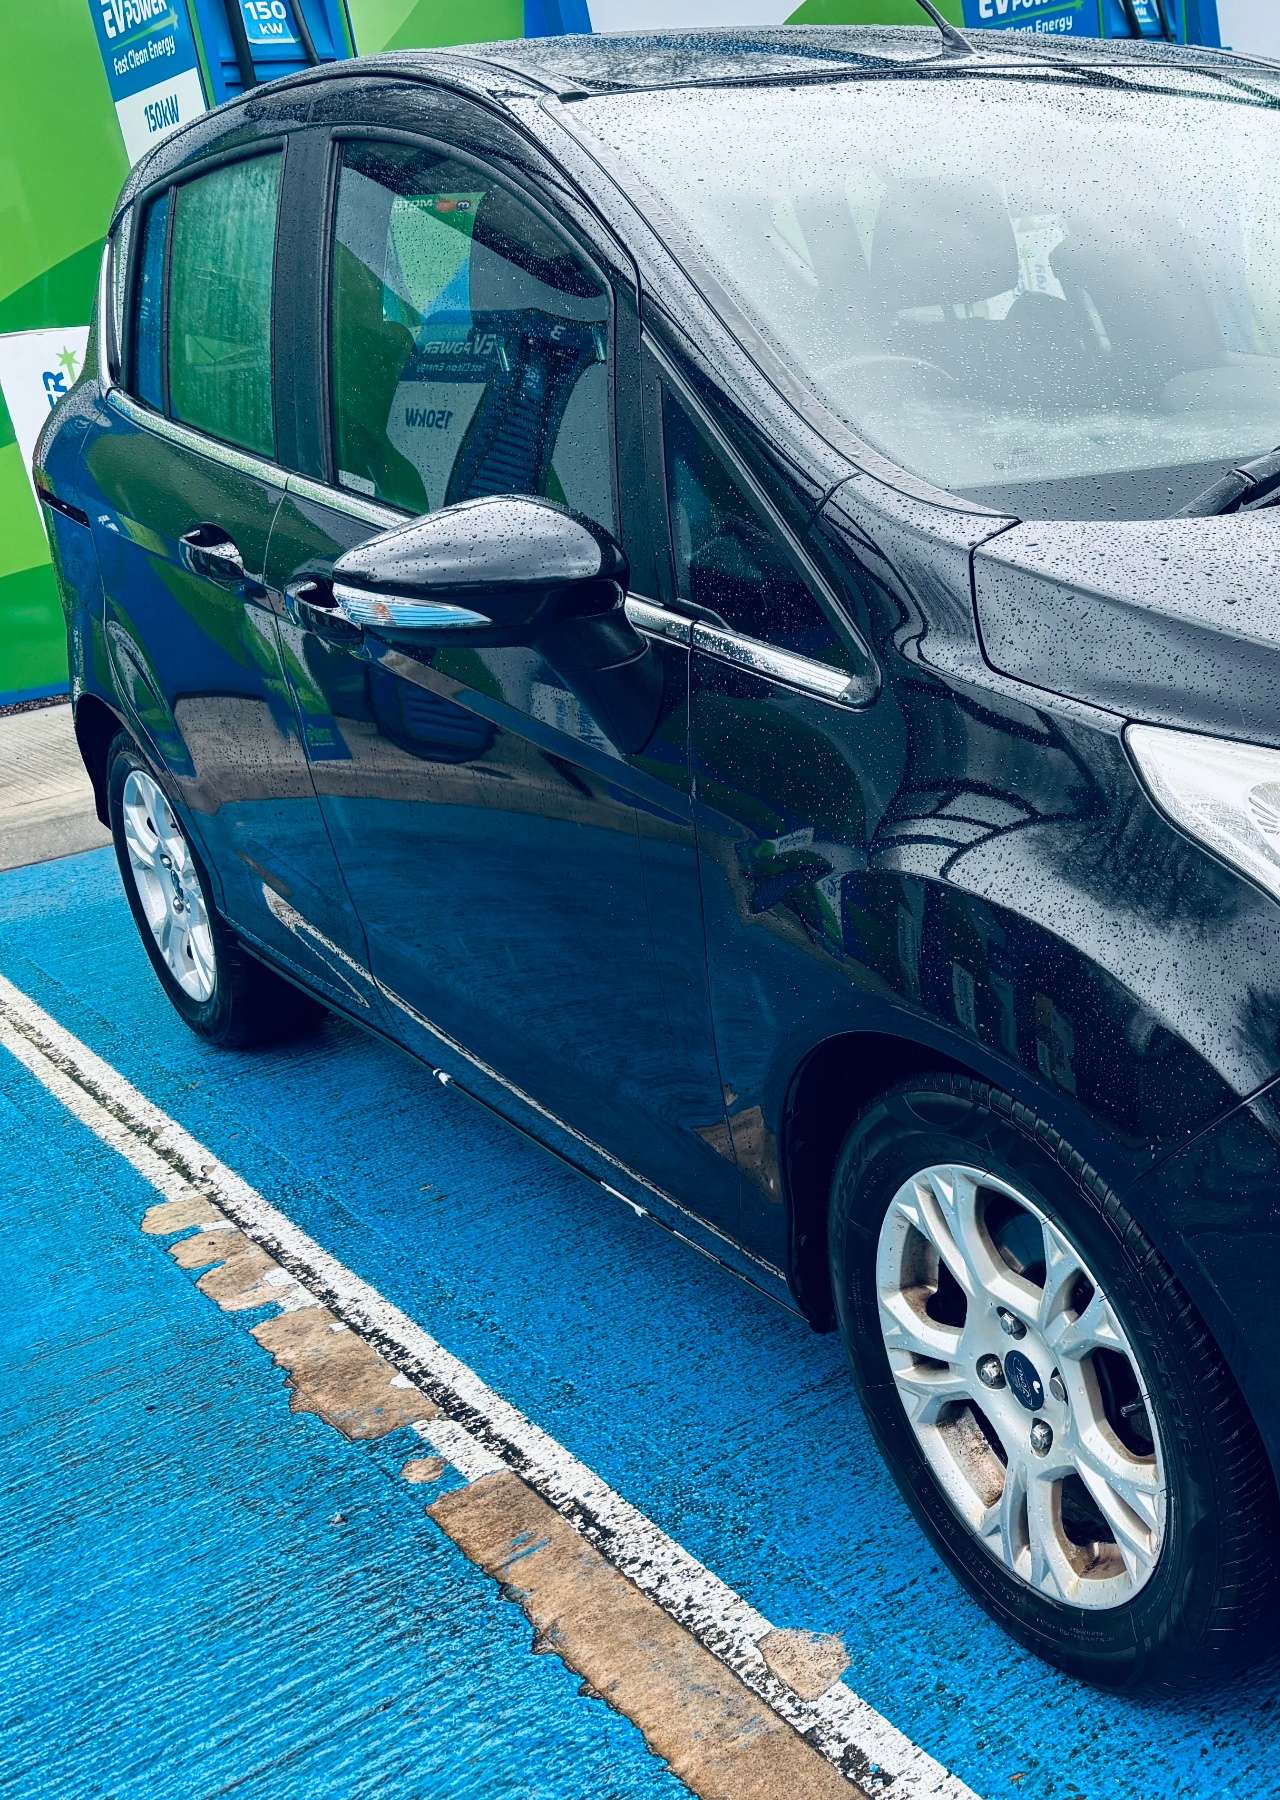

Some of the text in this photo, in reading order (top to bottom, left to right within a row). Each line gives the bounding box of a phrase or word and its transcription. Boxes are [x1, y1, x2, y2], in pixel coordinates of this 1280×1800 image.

[244, 0, 287, 20] 150
[258, 22, 283, 35] kW
[1035, 16, 1073, 33] Energy
[113, 34, 176, 76] Fast Clean Energy
[144, 94, 180, 133] 150kW
